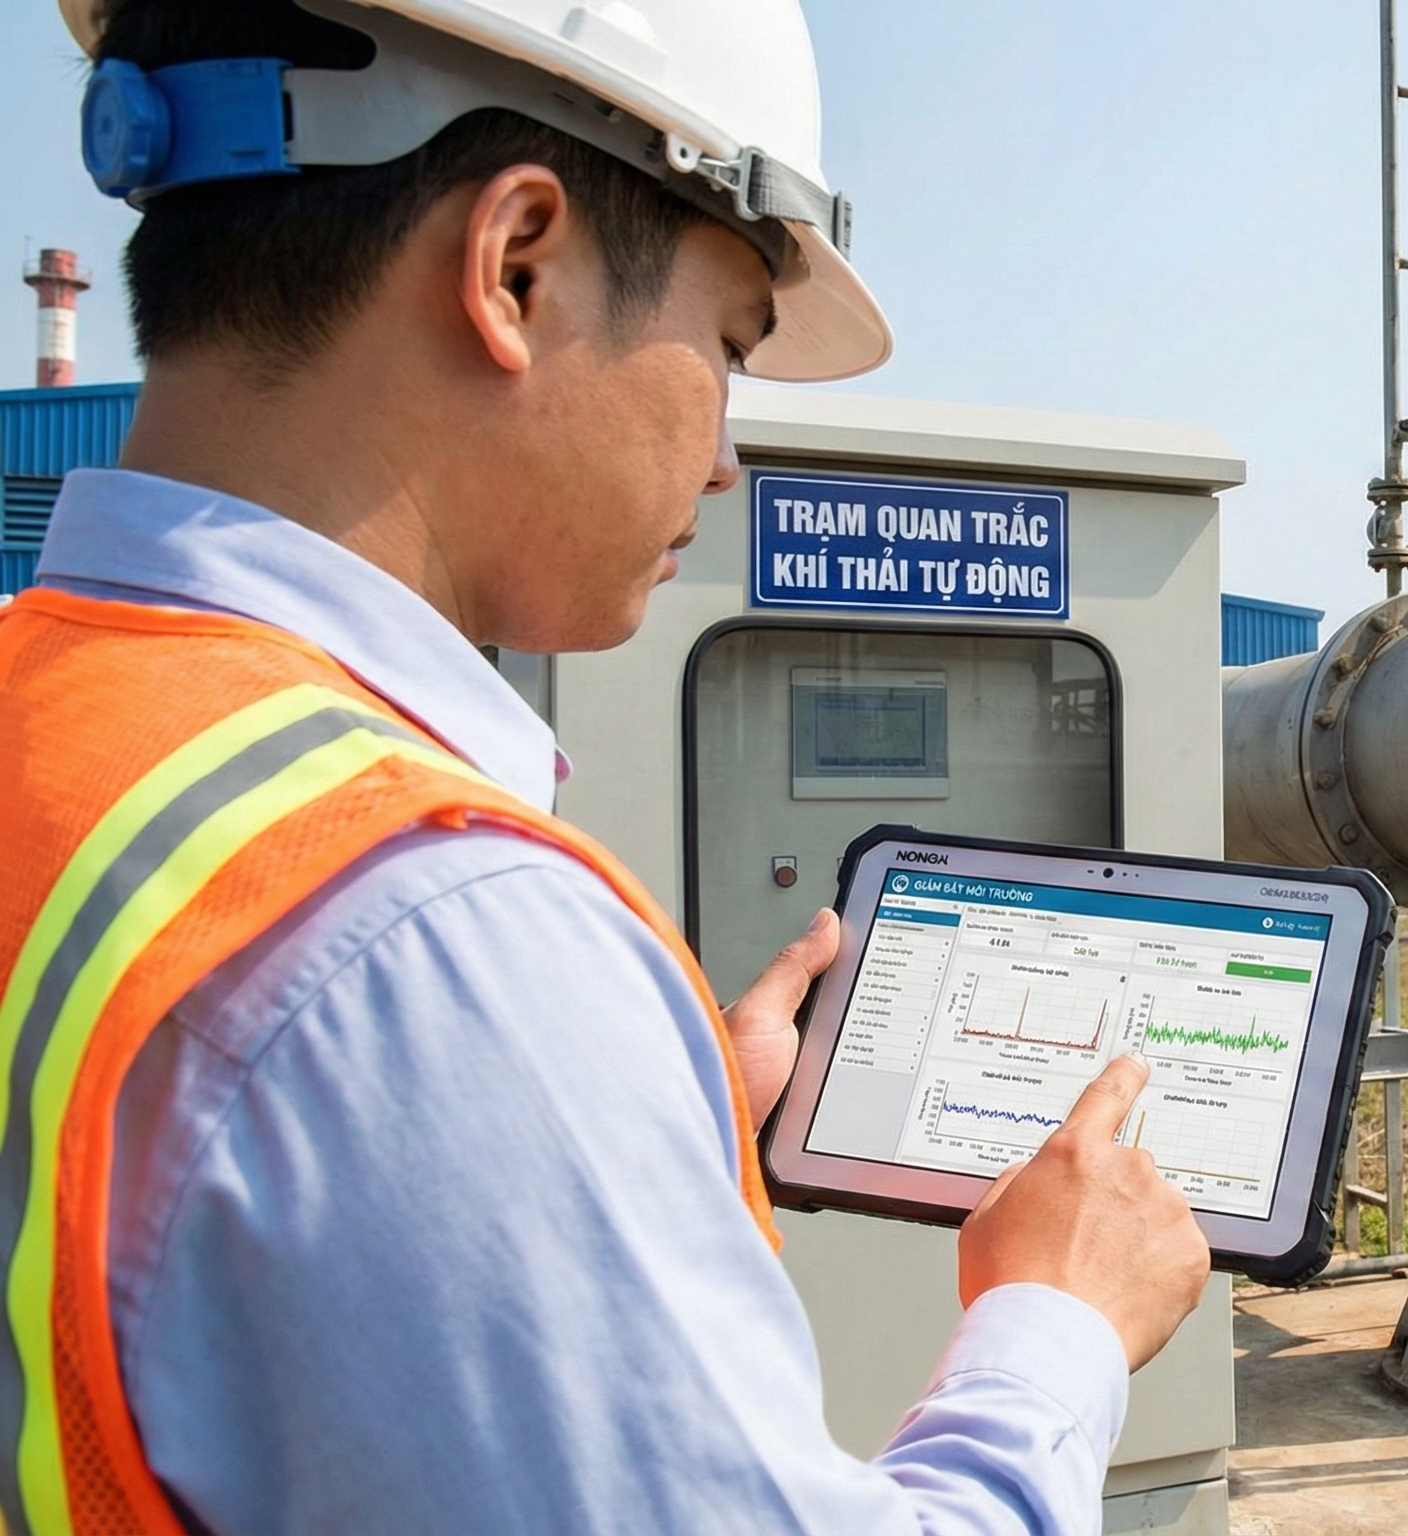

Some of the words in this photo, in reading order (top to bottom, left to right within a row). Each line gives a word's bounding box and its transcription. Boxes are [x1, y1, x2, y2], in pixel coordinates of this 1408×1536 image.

[773, 499, 866, 542] TRẠM
[877, 504, 961, 542] QUAN
[971, 501, 1049, 547] TRẮC
[773, 548, 827, 588] KHÍ
[837, 546, 908, 592] THẢI
[919, 559, 961, 601] TỰ
[966, 557, 1050, 603] ĐỘNG
